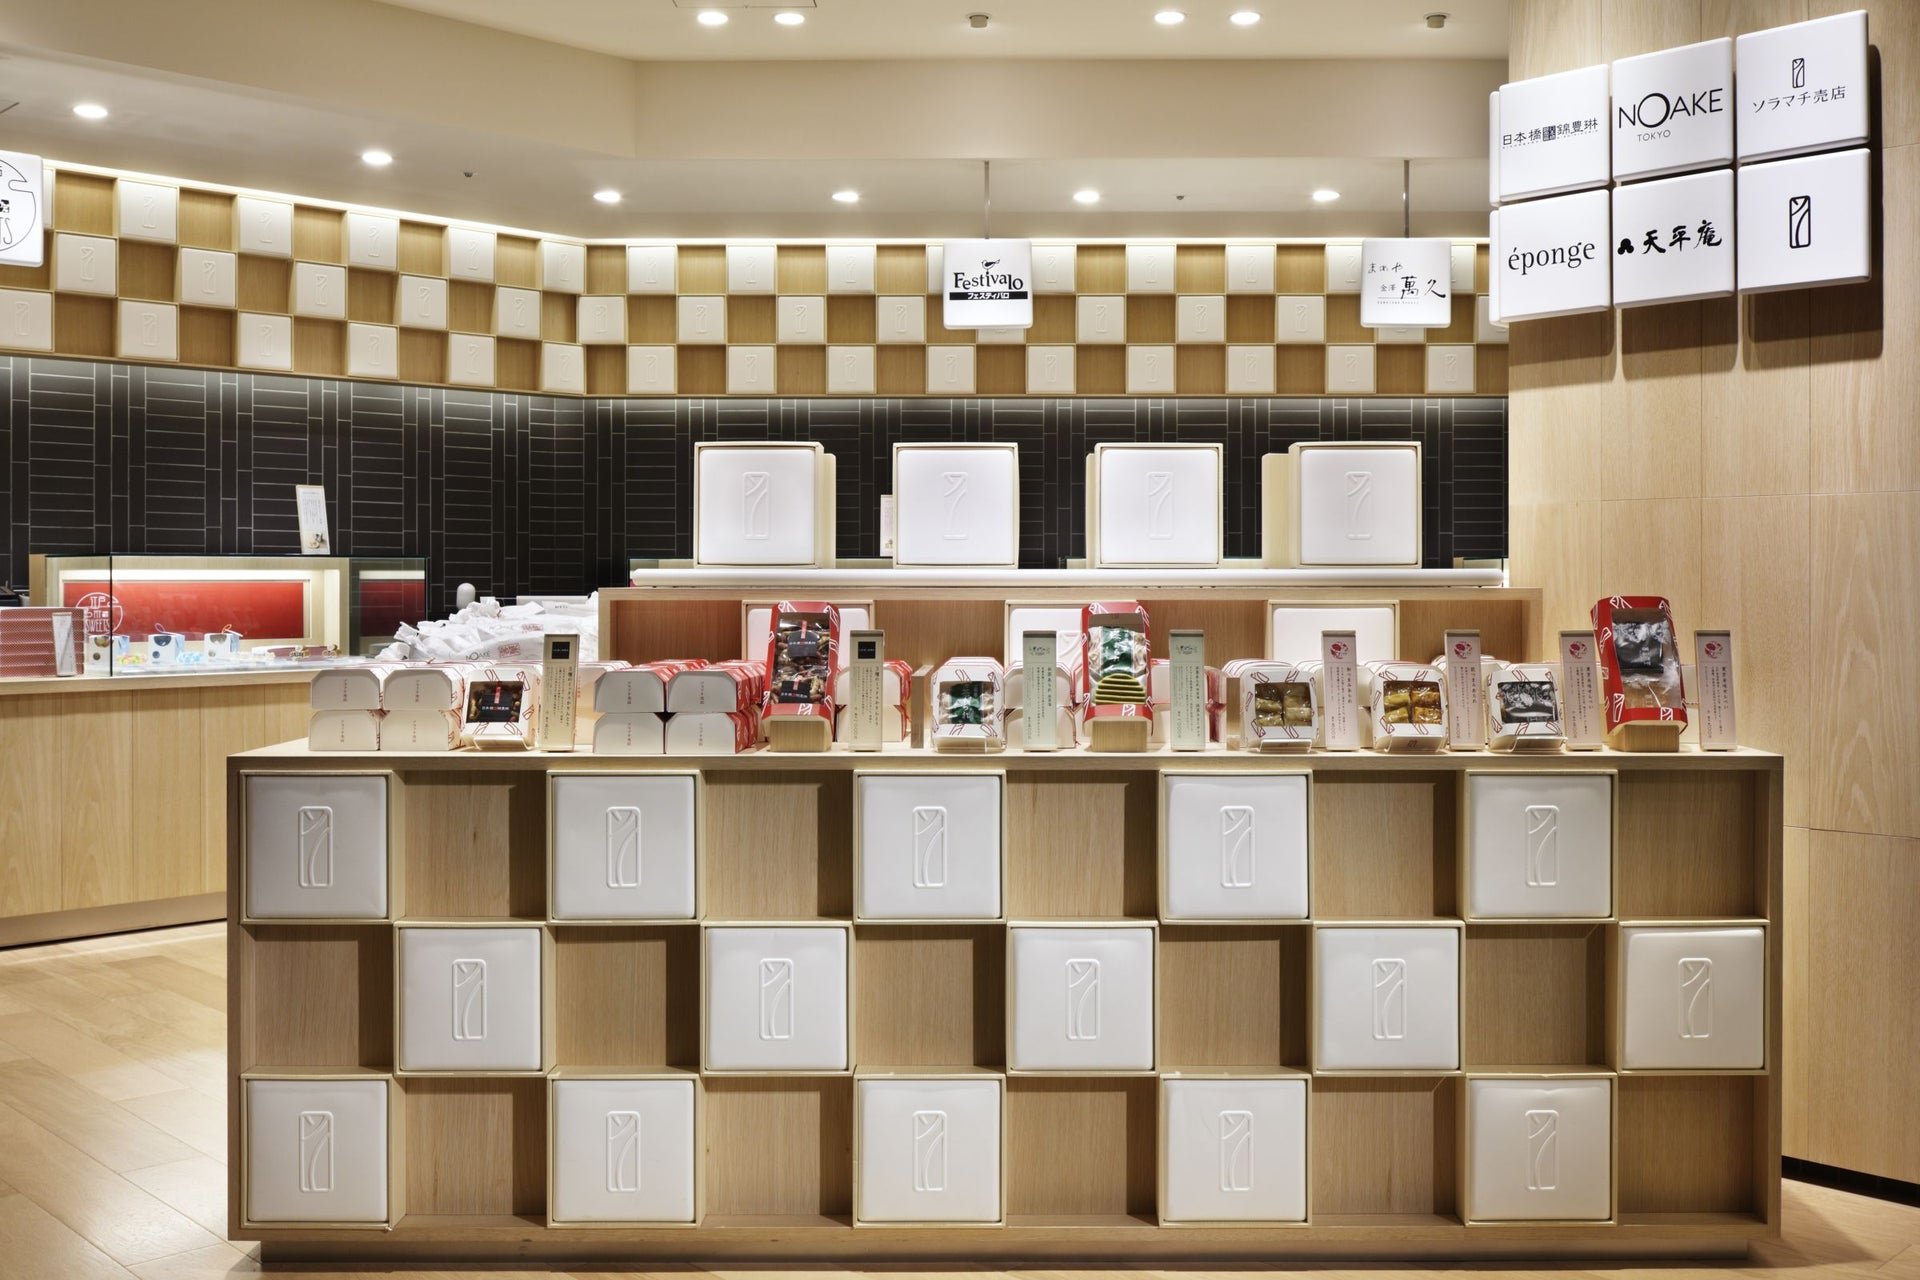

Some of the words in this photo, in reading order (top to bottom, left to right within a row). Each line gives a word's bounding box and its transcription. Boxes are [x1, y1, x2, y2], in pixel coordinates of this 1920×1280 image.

[1618, 88, 1723, 129] NOAKE
[1752, 86, 1846, 113] ソラマチ売店
[1637, 129, 1671, 142] TOKYO
[1642, 219, 1723, 254] 天平庵
[1508, 241, 1596, 275] éponge
[953, 270, 1024, 290] Festivalo
[967, 292, 1010, 300] フェスティバロ
